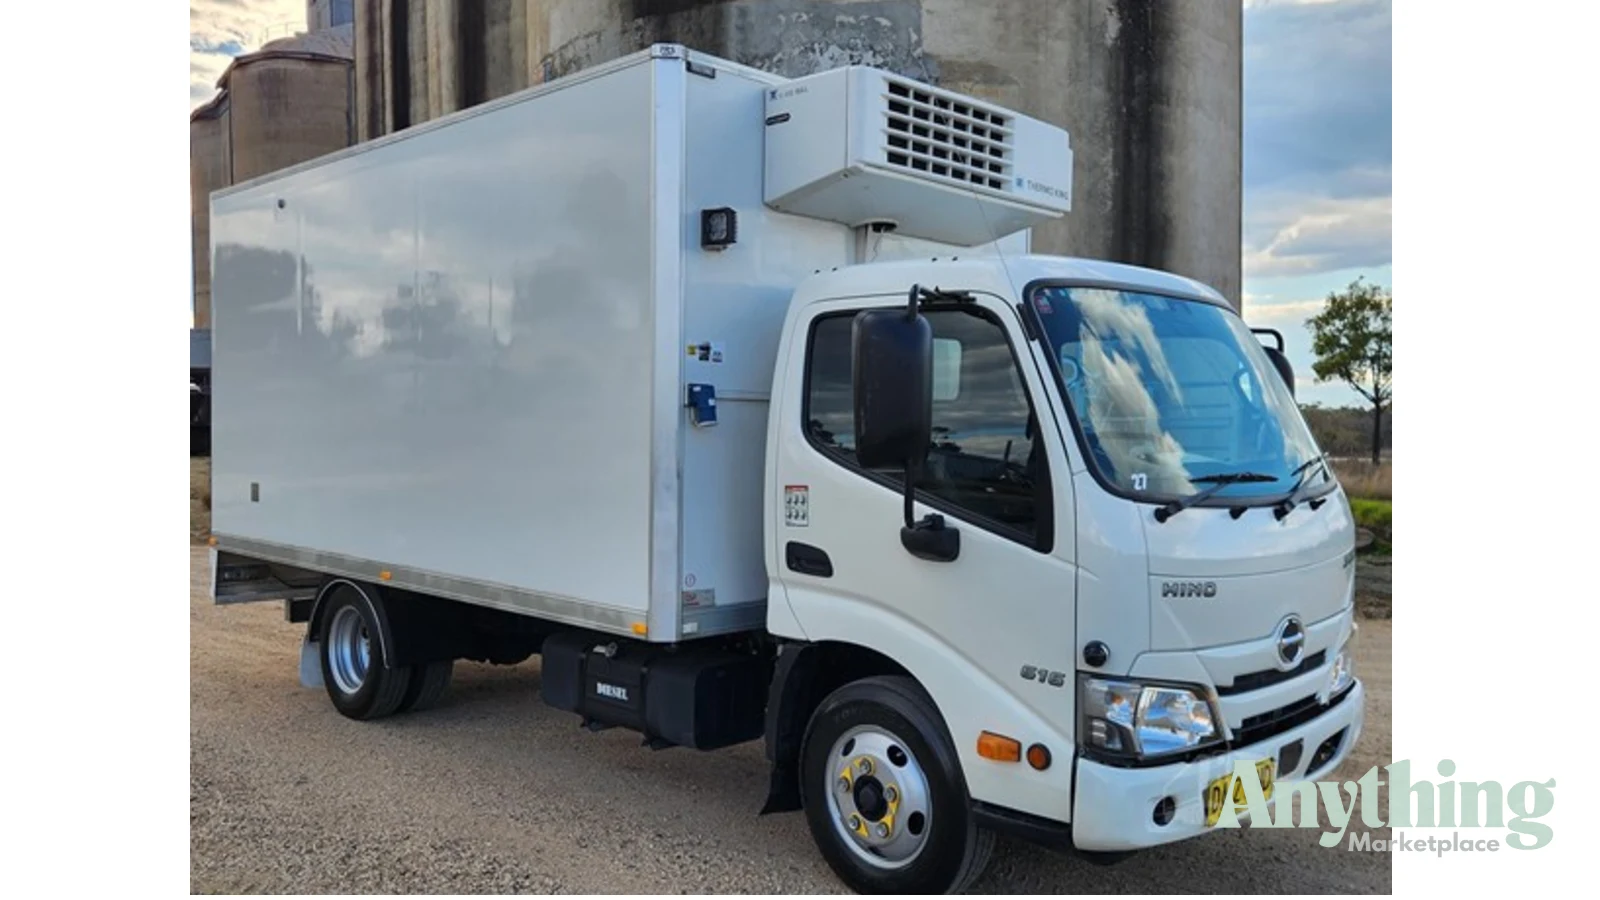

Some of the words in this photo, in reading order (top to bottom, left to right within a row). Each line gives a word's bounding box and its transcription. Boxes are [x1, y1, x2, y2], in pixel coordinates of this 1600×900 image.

[1131, 473, 1147, 491] 27
[1162, 582, 1217, 598] HINO
[1020, 665, 1066, 688] 616
[596, 682, 629, 701] DIESEL
